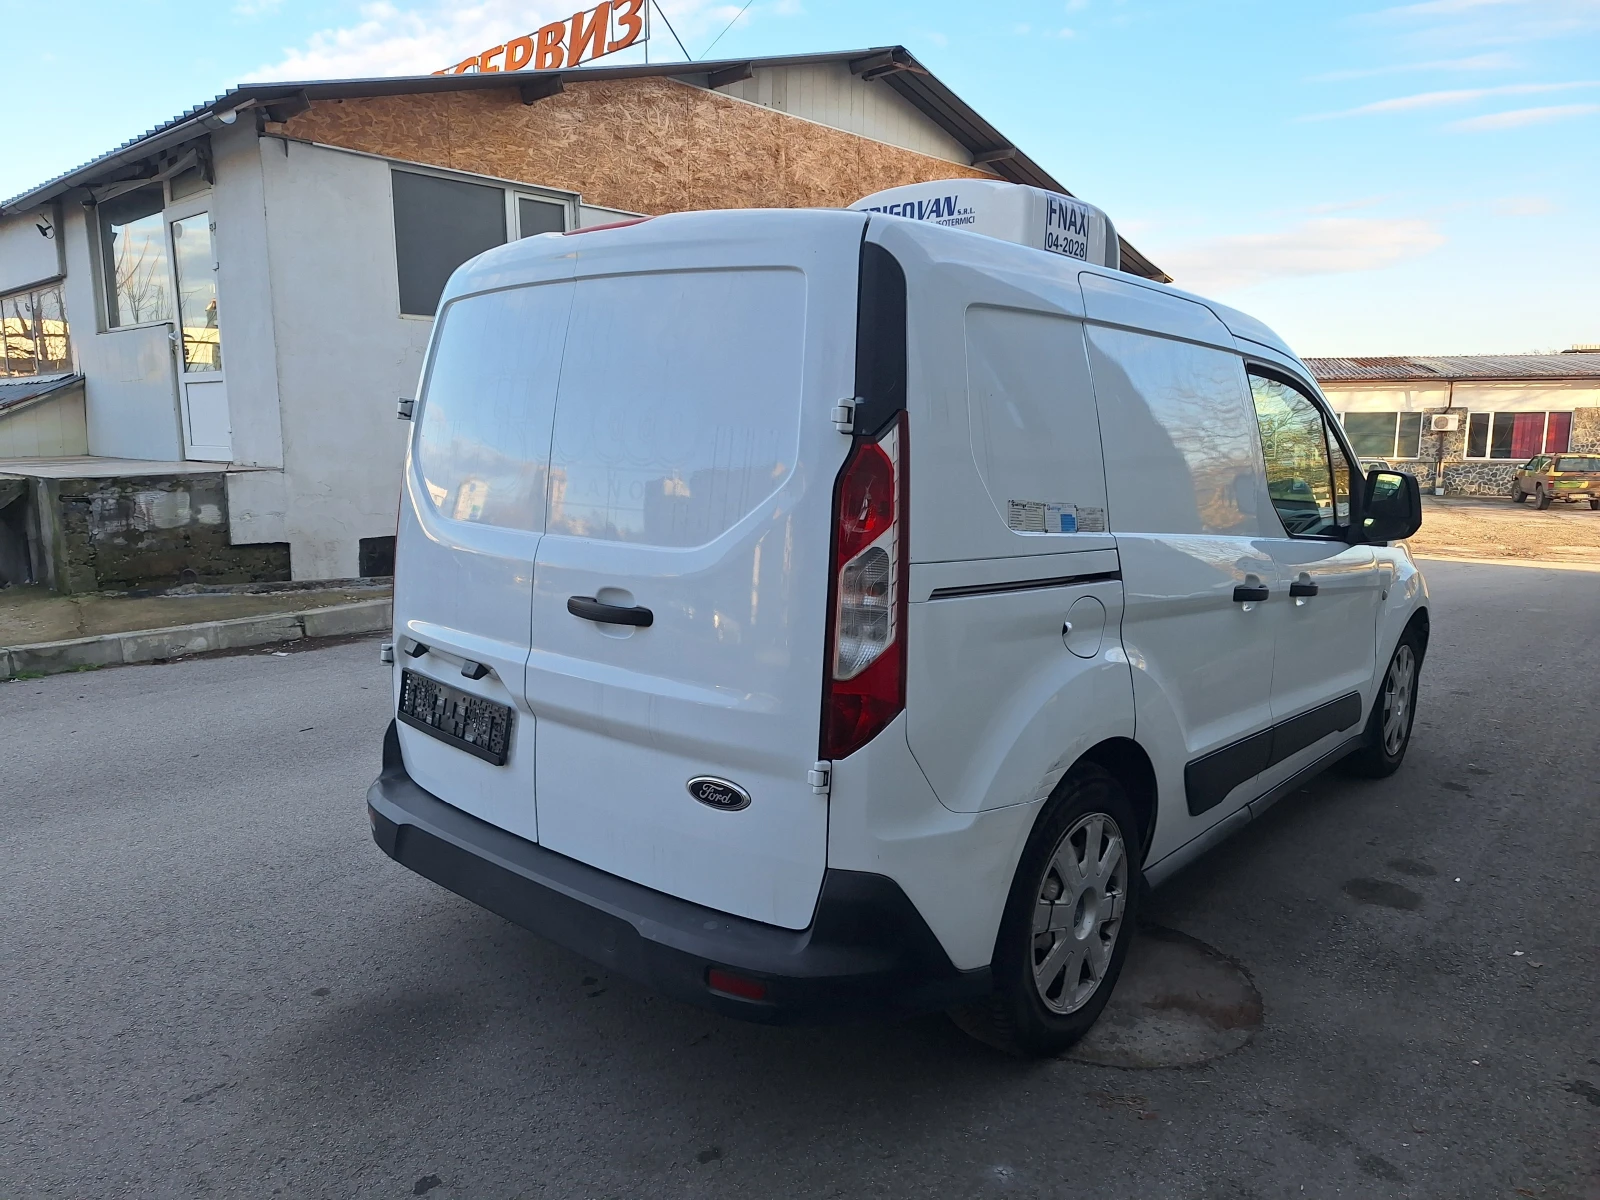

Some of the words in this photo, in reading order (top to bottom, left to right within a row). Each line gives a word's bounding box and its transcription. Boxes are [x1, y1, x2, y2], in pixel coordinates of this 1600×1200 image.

[859, 194, 958, 221] GOVAN
[957, 207, 976, 216] S.R.L.
[1048, 196, 1087, 238] FNAX
[1047, 231, 1086, 259] 04-2028
[699, 783, 733, 804] Ford
